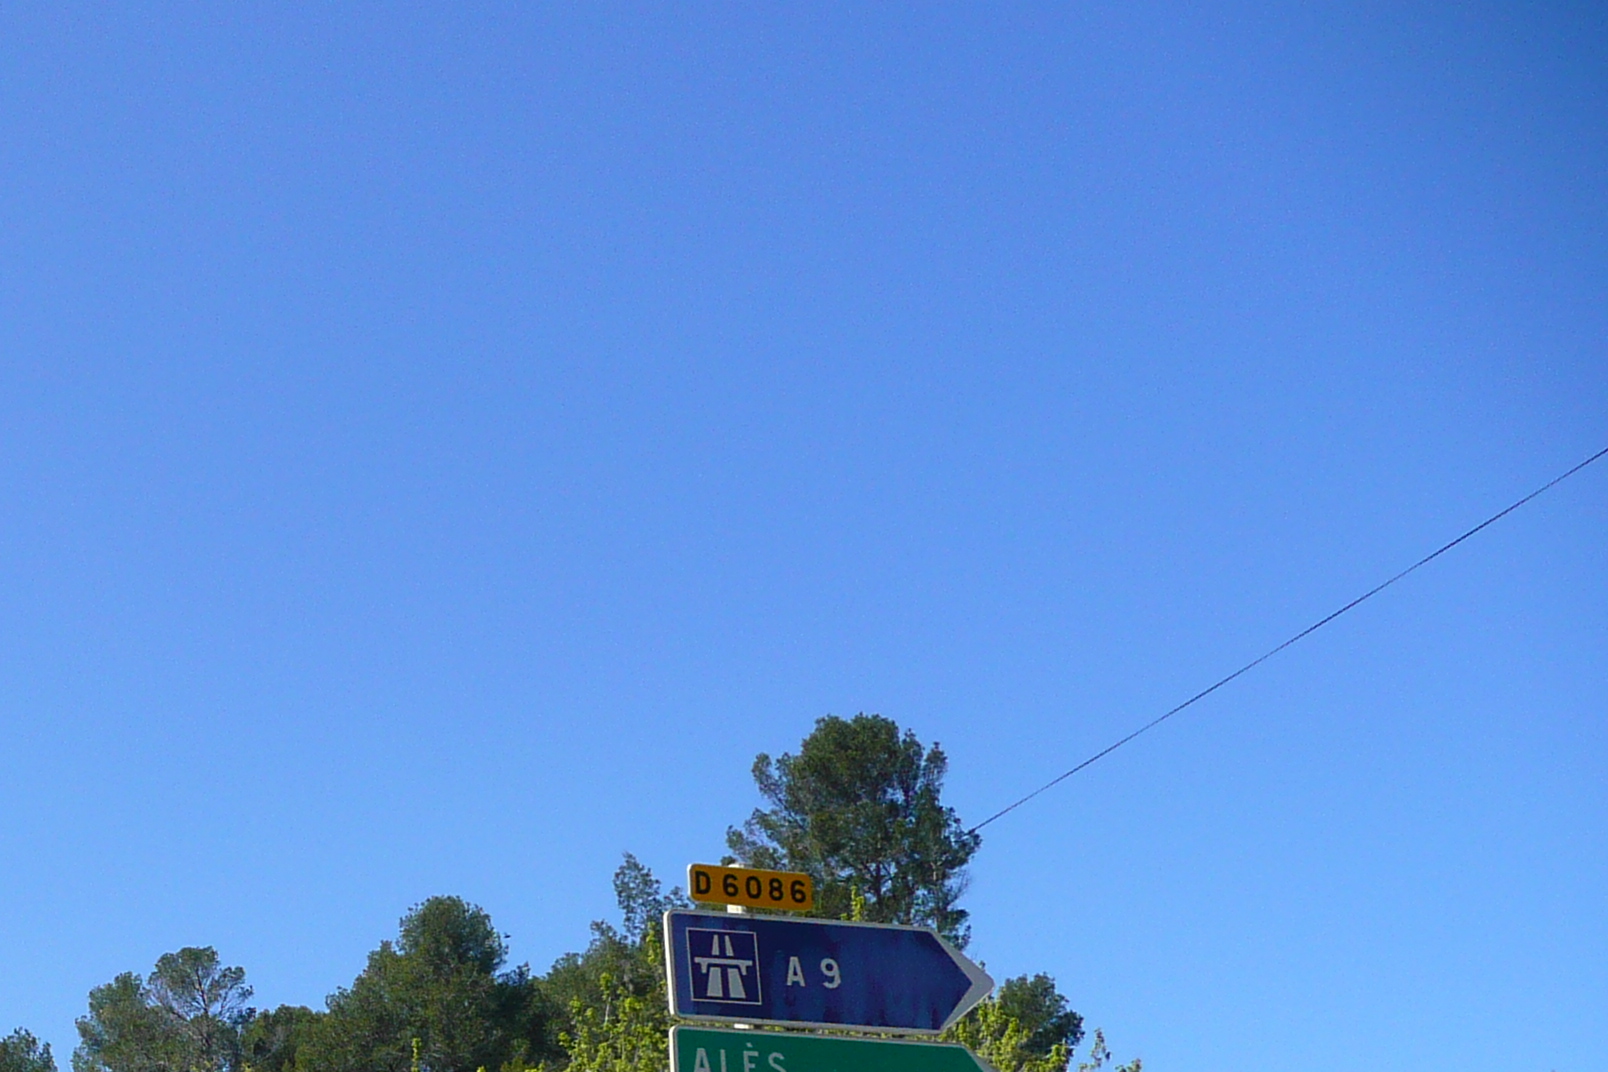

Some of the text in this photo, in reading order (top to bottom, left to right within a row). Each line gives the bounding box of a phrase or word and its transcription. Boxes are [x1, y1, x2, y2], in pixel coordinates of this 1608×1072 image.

[694, 871, 807, 902] D 6086
[786, 956, 842, 989] A 9
